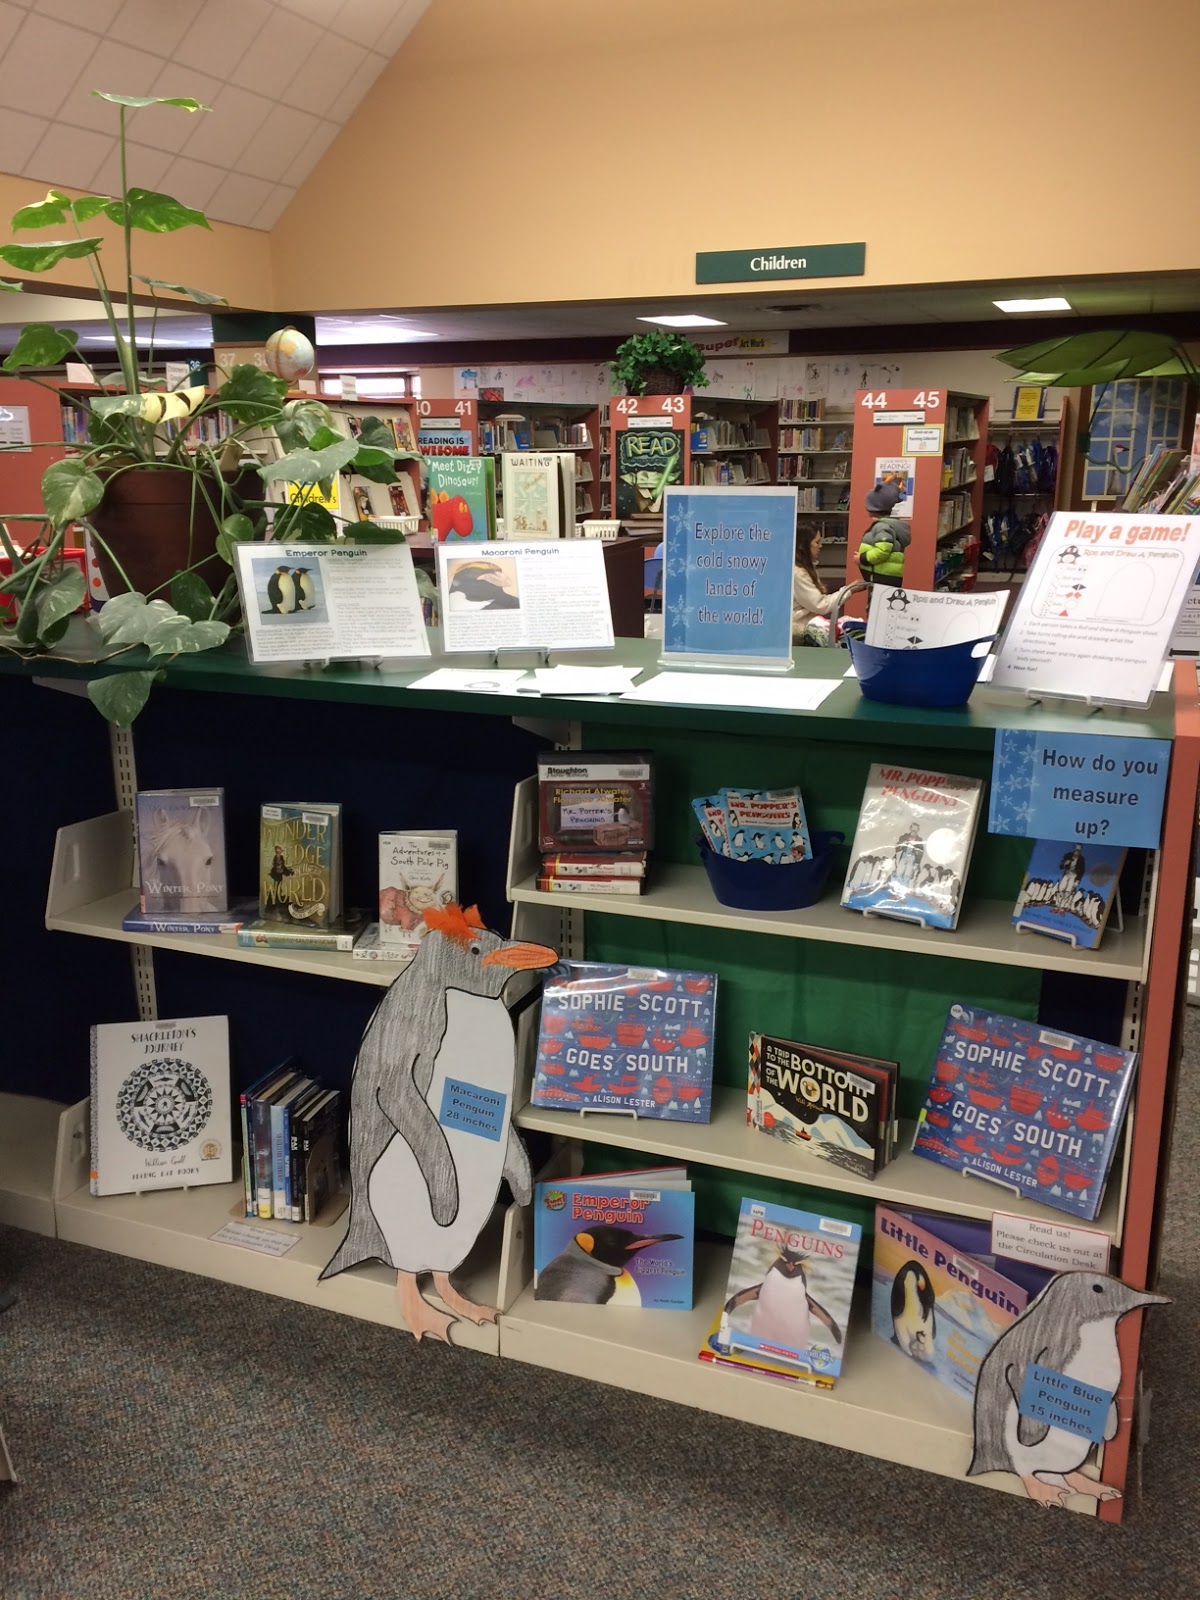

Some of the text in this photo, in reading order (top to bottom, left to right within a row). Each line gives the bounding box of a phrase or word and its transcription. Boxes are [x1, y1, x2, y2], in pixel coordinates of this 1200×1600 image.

[749, 254, 807, 272] Children
[740, 339, 750, 348] Art
[751, 338, 765, 348] Work
[218, 353, 236, 367] 37
[454, 401, 472, 415] 41
[616, 397, 685, 415] 42 43
[861, 391, 940, 409] 44 45
[418, 437, 464, 445] READING IS
[627, 436, 677, 457] READ
[418, 445, 470, 457] WESOME
[431, 459, 482, 474] Meet Dizzy
[511, 458, 551, 467] WAITING
[437, 474, 479, 489] Dinosaur!
[695, 522, 772, 545] Explore the
[1064, 519, 1192, 545] Play a game!
[285, 549, 368, 558] Emperor Penguin
[524, 548, 560, 556] Penguin
[1116, 550, 1138, 558] Draw
[696, 551, 768, 575] cold snowy
[705, 578, 757, 597] lands of
[929, 596, 944, 604] and
[946, 597, 965, 606] Draw
[698, 605, 764, 624] the world!
[547, 766, 588, 774] Stoughton
[1042, 748, 1159, 777] How do you
[1053, 785, 1139, 806] measure
[739, 810, 791, 819] PENGUINS
[750, 801, 798, 810] POPPER'S
[1075, 818, 1110, 839] up?
[392, 846, 435, 856] Adventures
[390, 856, 449, 871] South Pole Pig
[263, 876, 326, 907] WORLD
[557, 992, 703, 1018] SOPHIE SCOTT
[143, 1041, 185, 1055] JOURNEY
[766, 1045, 790, 1059] A TRIP
[565, 1048, 689, 1074] GOES SOUTH
[766, 1052, 777, 1062] TO
[777, 1057, 790, 1068] THE
[954, 1040, 1111, 1098] SOPHIE SCOTT
[765, 1067, 777, 1077] OF
[450, 1083, 501, 1106] Macaroni
[765, 1061, 869, 1123] THE WORLD
[452, 1097, 496, 1119] Penguin
[592, 1095, 656, 1109] ALISON LESTER
[446, 1109, 498, 1133] 28 inches
[951, 1100, 1084, 1159] GOES SOUTH
[971, 1156, 1039, 1189] ALISON LESTER
[572, 1192, 650, 1210] Emperor
[572, 1206, 644, 1225] Penguin
[749, 1218, 846, 1260] PENGUINS
[1029, 1223, 1071, 1239] Read us!
[996, 1229, 1104, 1259] Please check us out at
[998, 1241, 1014, 1251] the
[1015, 1244, 1069, 1264] Circulation
[635, 1258, 647, 1266] The
[879, 1217, 1021, 1318] Little Penguin
[1033, 1370, 1104, 1406] Little Blue
[1038, 1389, 1091, 1418] Penguin
[1029, 1403, 1093, 1436] 15 inches
